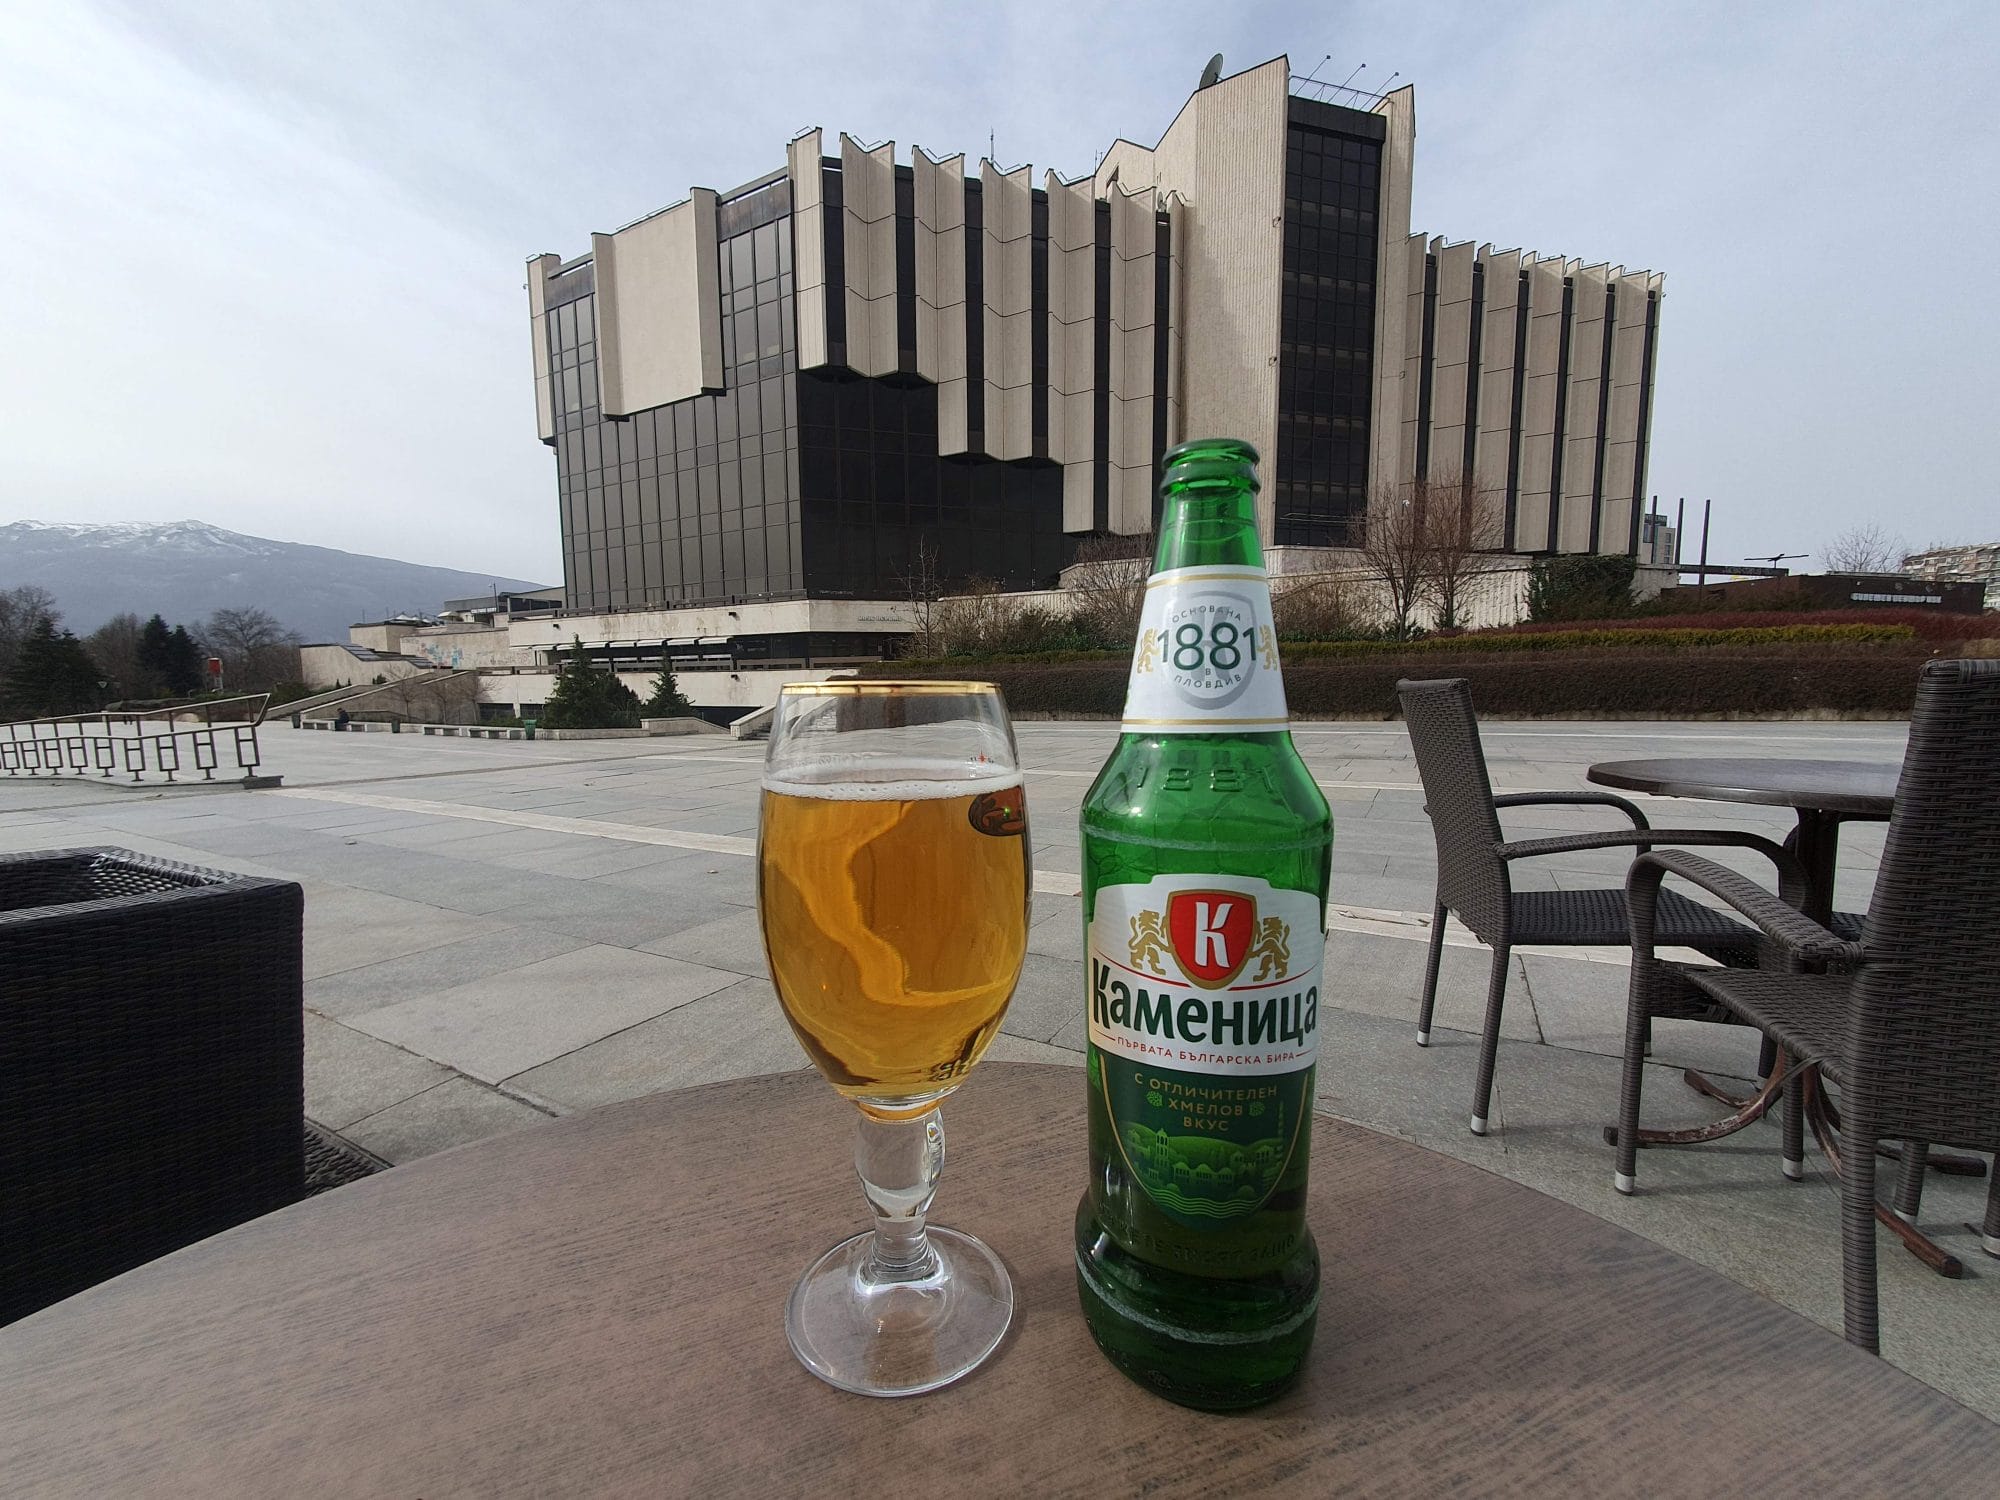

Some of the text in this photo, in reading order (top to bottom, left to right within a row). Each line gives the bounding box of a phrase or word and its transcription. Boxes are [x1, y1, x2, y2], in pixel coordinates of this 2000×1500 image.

[1172, 605, 1241, 623] ОСНОВАНА
[1157, 622, 1256, 671] 1881
[1174, 674, 1242, 689] ПЛОВДИВ
[1092, 957, 1318, 1047] Каменица
[1117, 1036, 1295, 1065] ПЪРВАТА БЪЛГАРСКА БИРА
[1134, 1072, 1277, 1100] С ОТЛИЧИТЕЛЕН
[1168, 1099, 1243, 1116] ХМЕЛОВ
[1183, 1116, 1229, 1131] ВКУС
